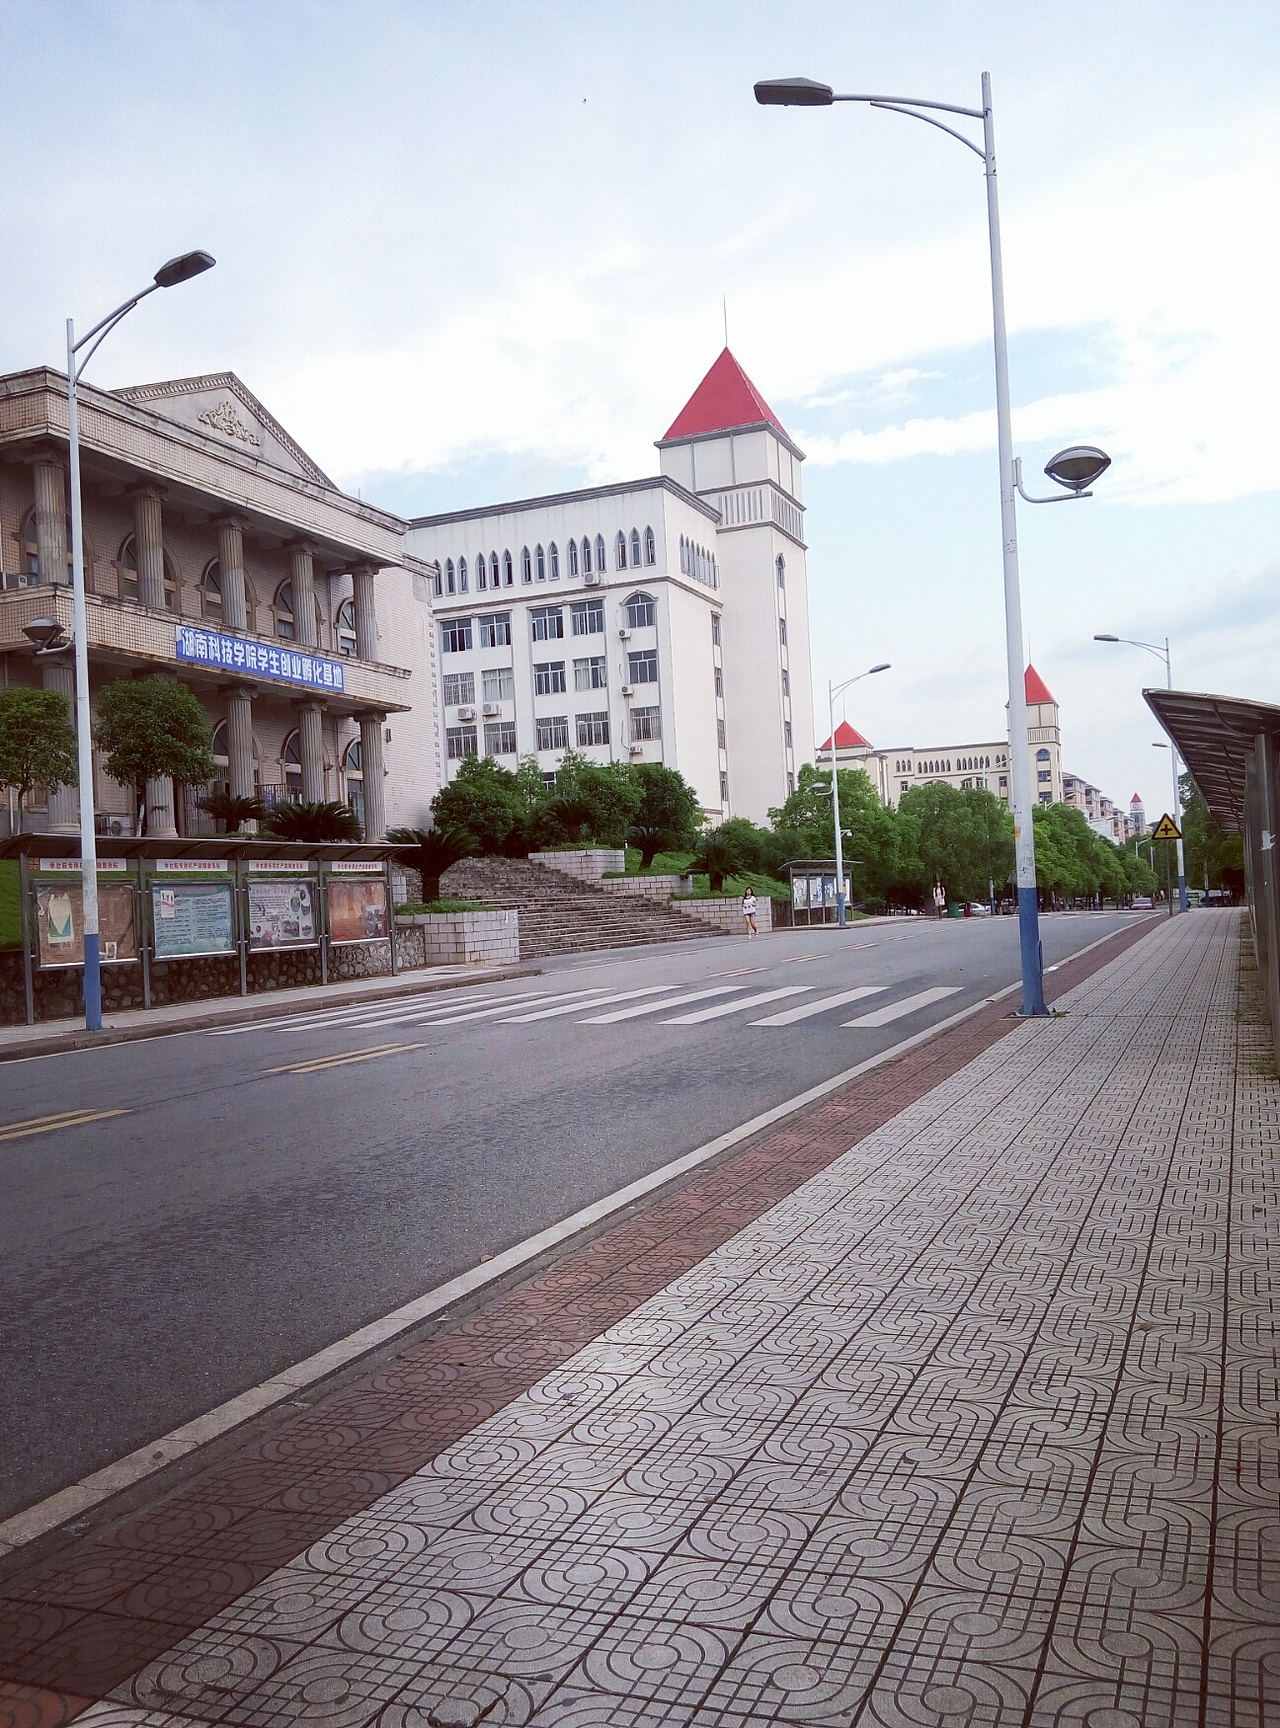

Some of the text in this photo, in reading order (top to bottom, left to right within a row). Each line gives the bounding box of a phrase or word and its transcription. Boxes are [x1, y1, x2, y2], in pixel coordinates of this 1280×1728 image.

[181, 628, 343, 688] 湖南科技学院学生创业孵化基地
